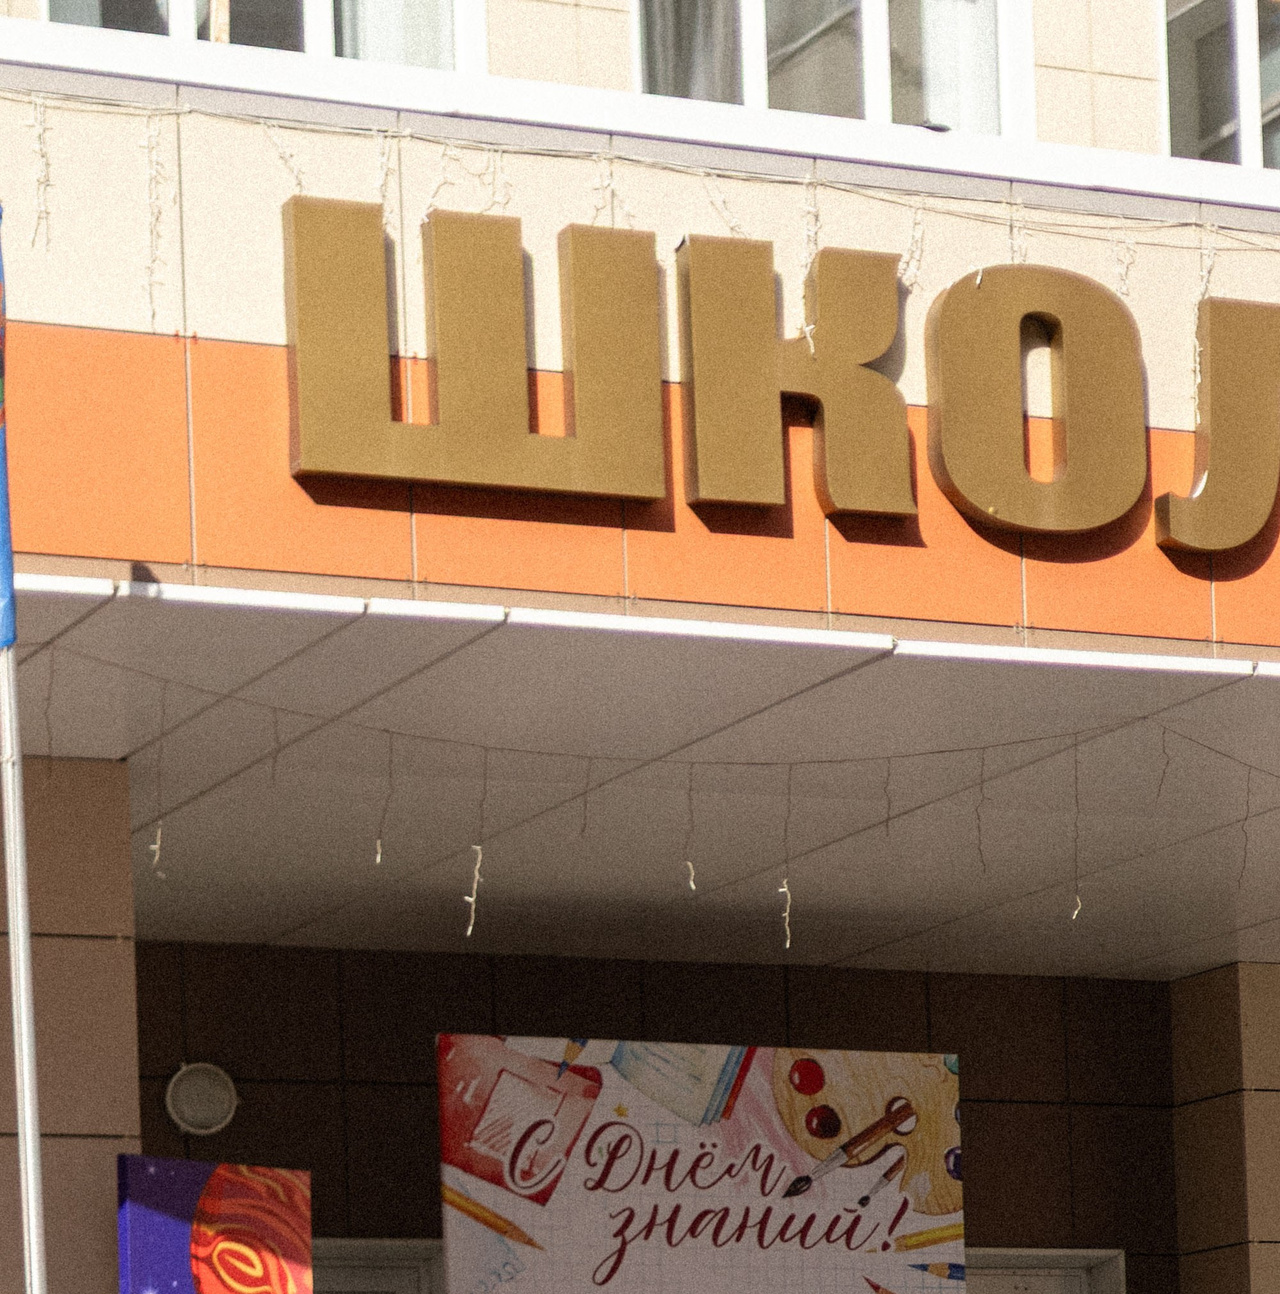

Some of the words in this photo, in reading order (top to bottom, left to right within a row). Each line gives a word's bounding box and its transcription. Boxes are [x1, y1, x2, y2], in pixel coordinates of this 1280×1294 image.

[507, 1119, 566, 1189] С
[584, 1120, 787, 1197] Днём
[593, 1197, 909, 1286] знаний!
